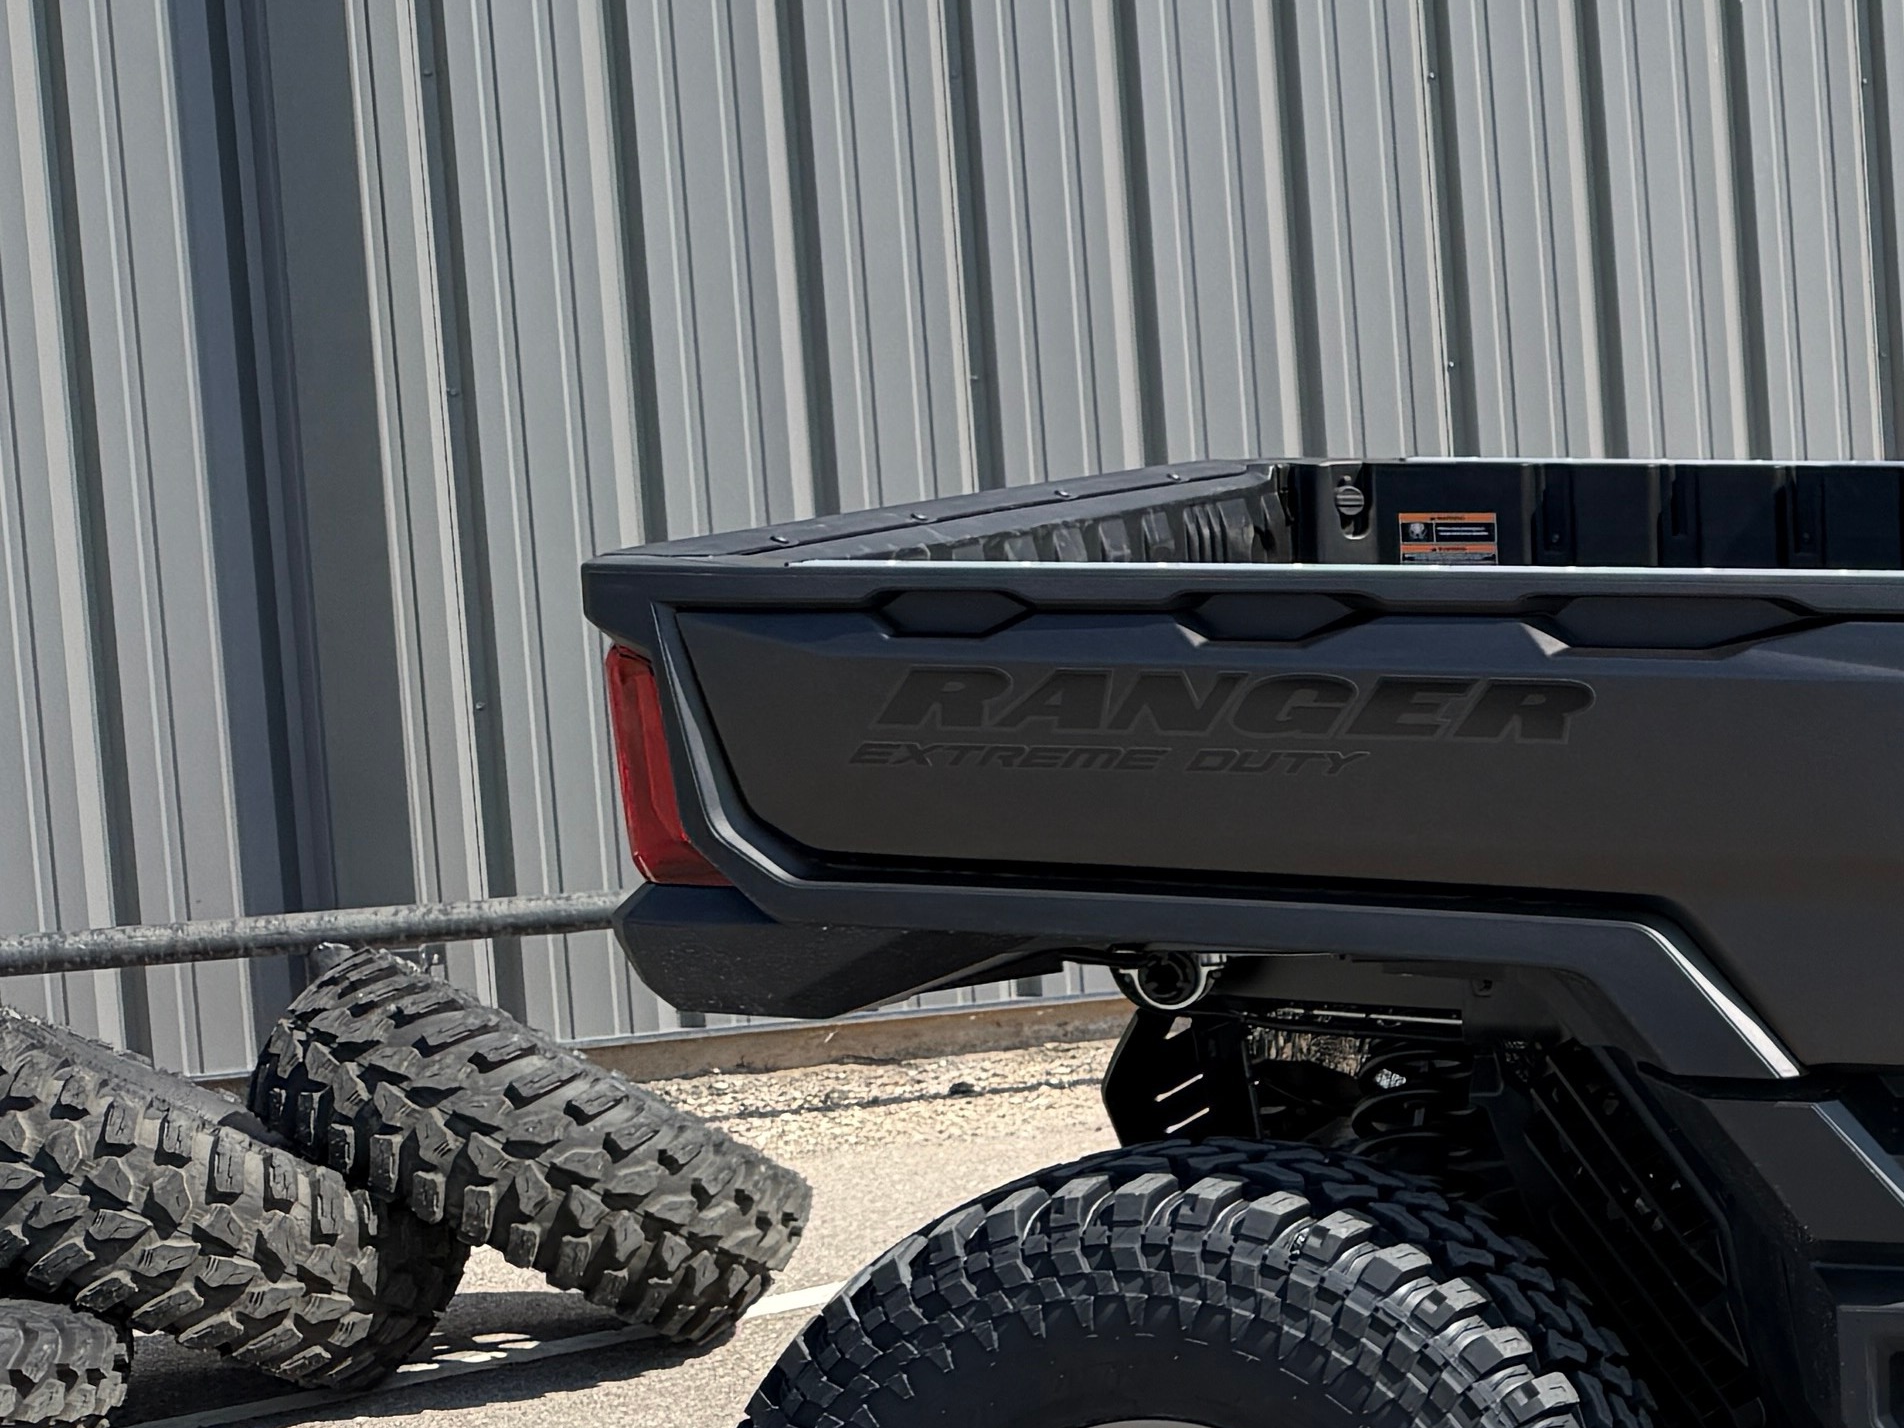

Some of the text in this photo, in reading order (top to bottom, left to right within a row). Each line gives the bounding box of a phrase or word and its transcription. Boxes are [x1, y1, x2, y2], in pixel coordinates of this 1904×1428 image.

[870, 665, 1596, 746] RANGER
[848, 740, 1371, 775] EXTREME DUTY
